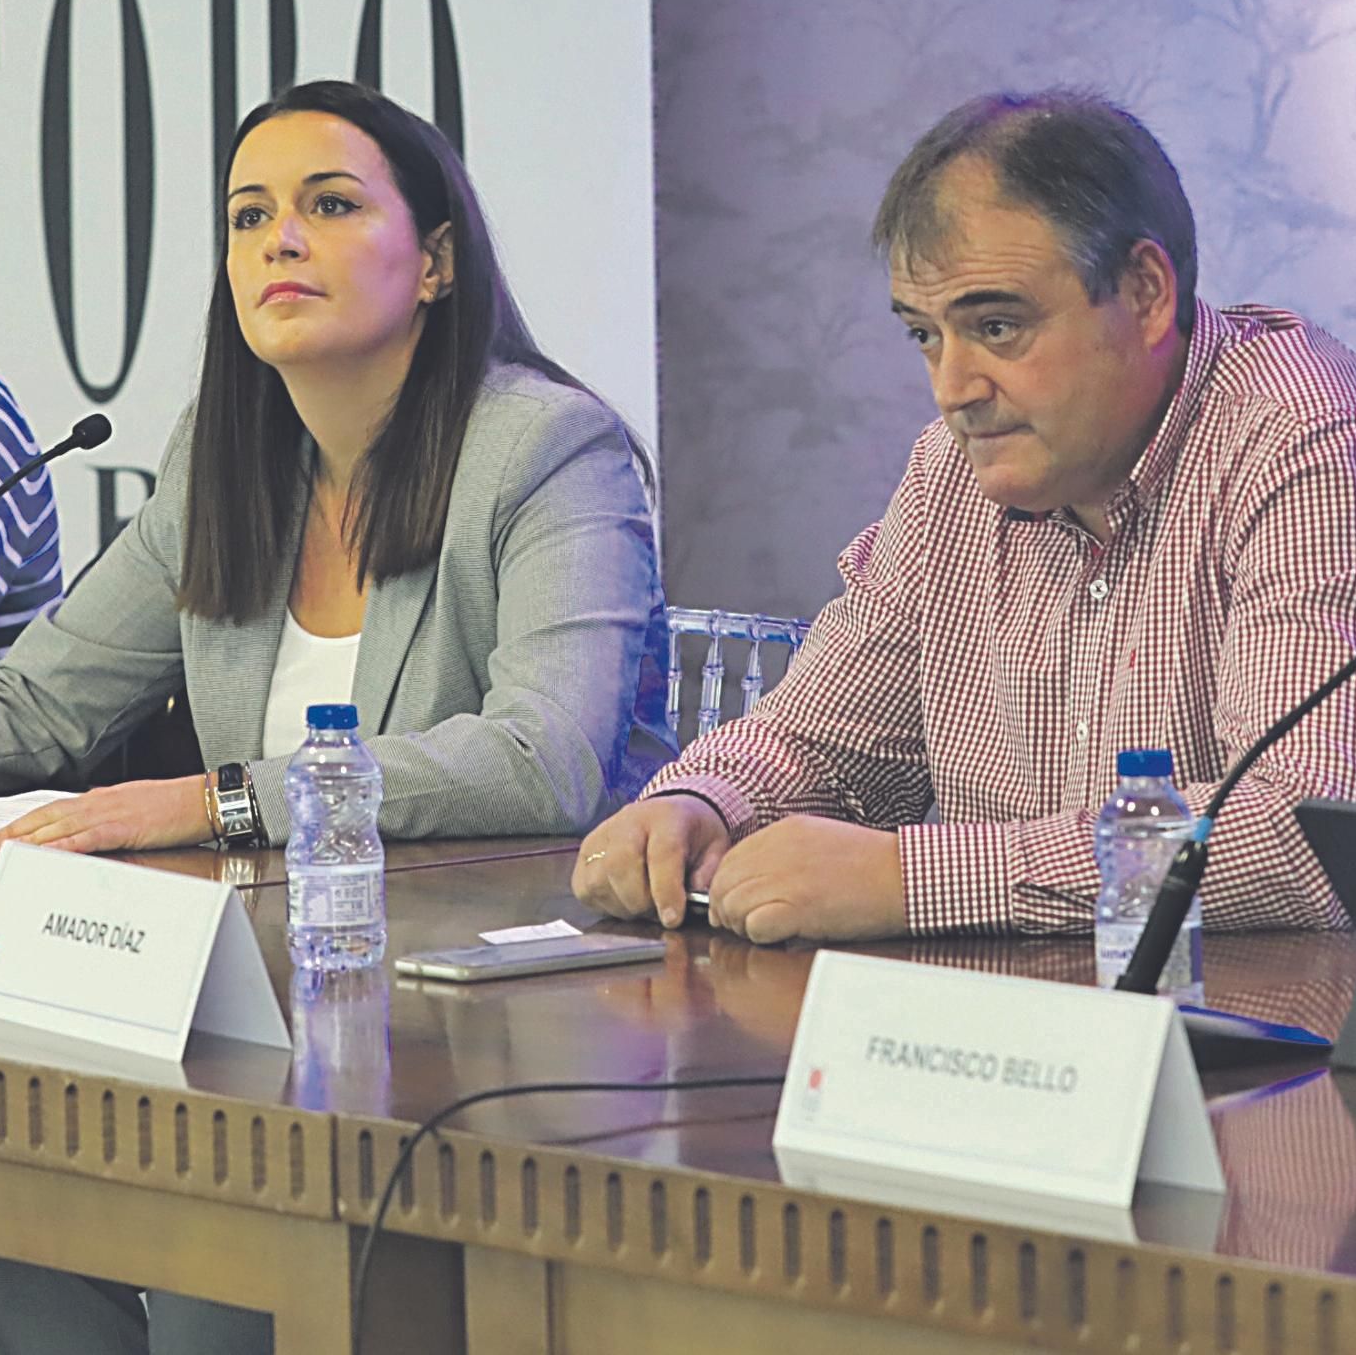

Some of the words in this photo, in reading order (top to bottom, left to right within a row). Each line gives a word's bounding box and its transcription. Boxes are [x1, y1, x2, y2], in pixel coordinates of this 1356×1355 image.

[42, 912, 108, 946] AMADOR
[109, 921, 145, 954] DÍAZ
[865, 1035, 998, 1082] FRANCISCO
[1001, 1055, 1078, 1093] BELLO
